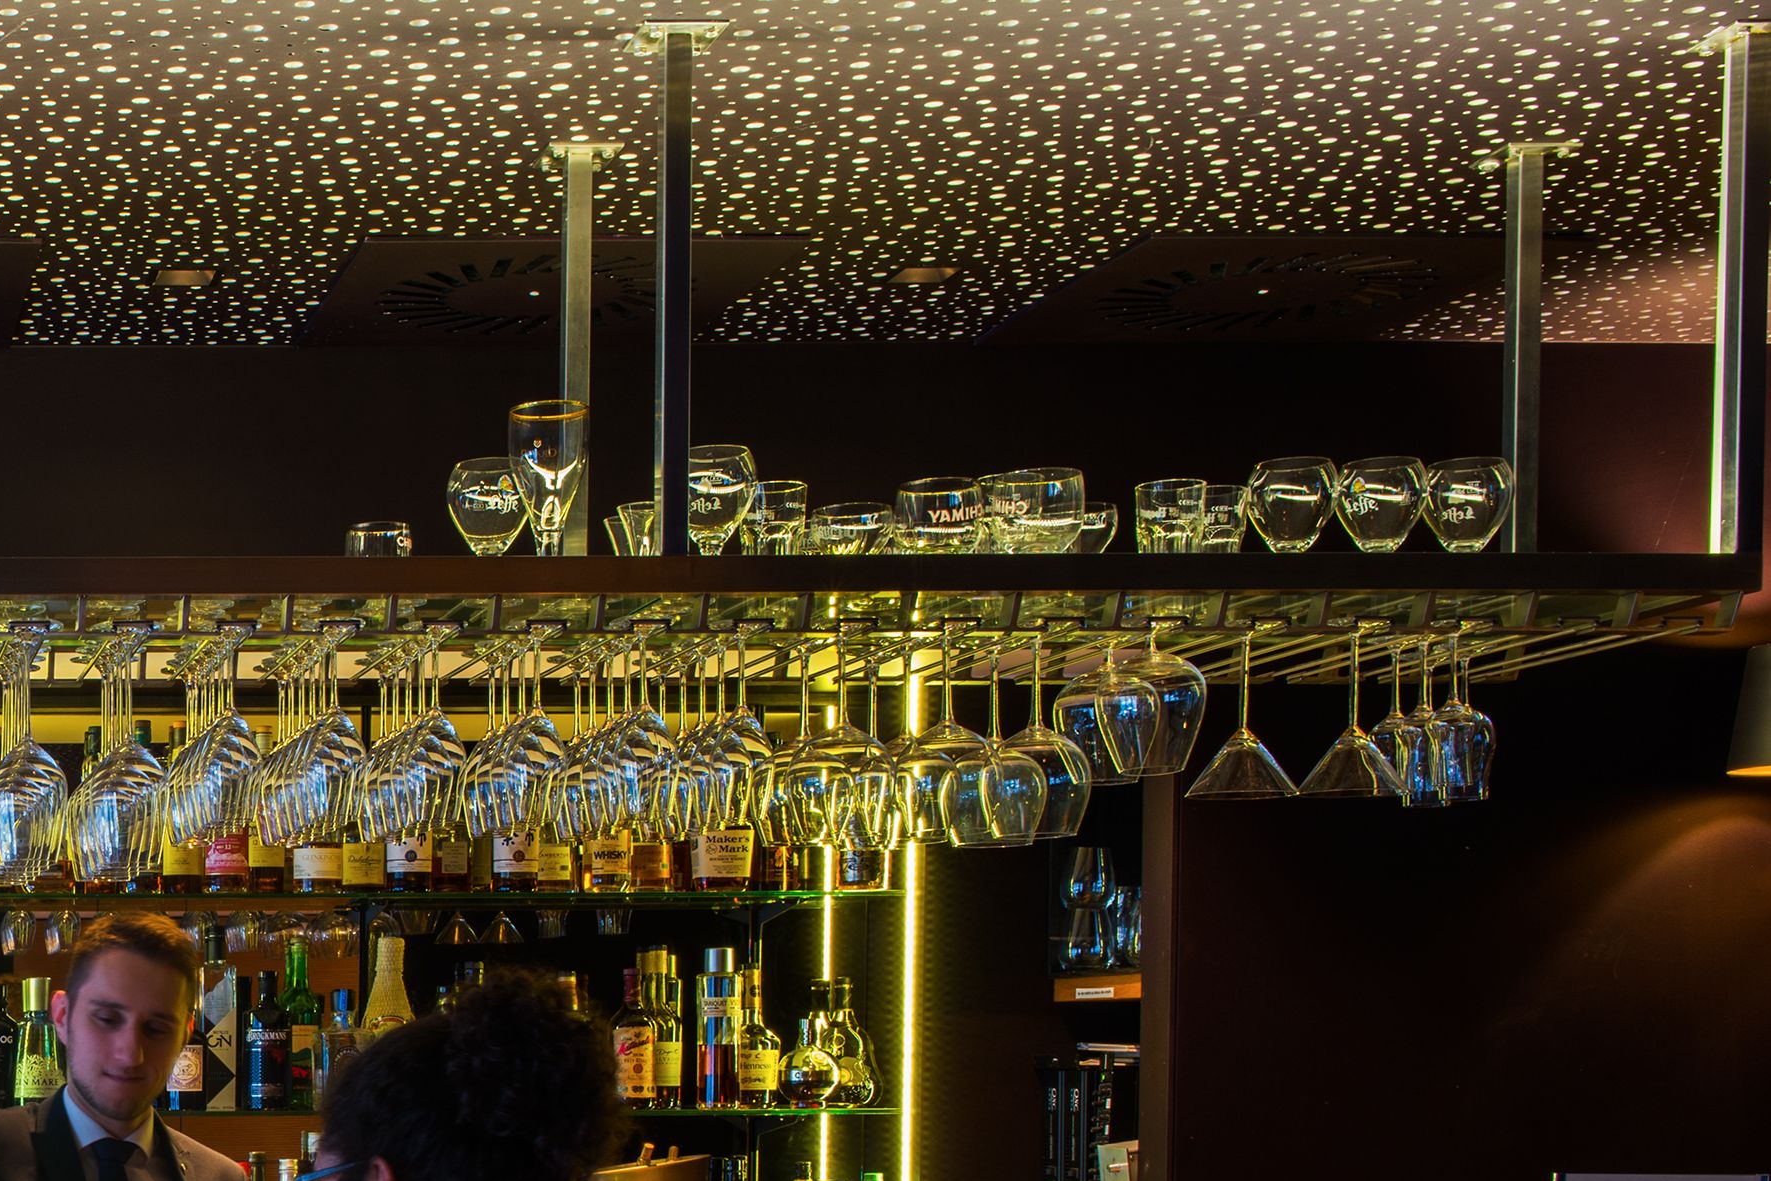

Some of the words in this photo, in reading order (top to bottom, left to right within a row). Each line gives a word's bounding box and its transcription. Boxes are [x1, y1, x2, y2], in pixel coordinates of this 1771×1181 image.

[706, 835, 750, 844] Maker's
[718, 845, 749, 853] Mark
[593, 850, 627, 860] WHISKY
[246, 1028, 287, 1042] BROCKMANS
[31, 1078, 59, 1086] MARE
